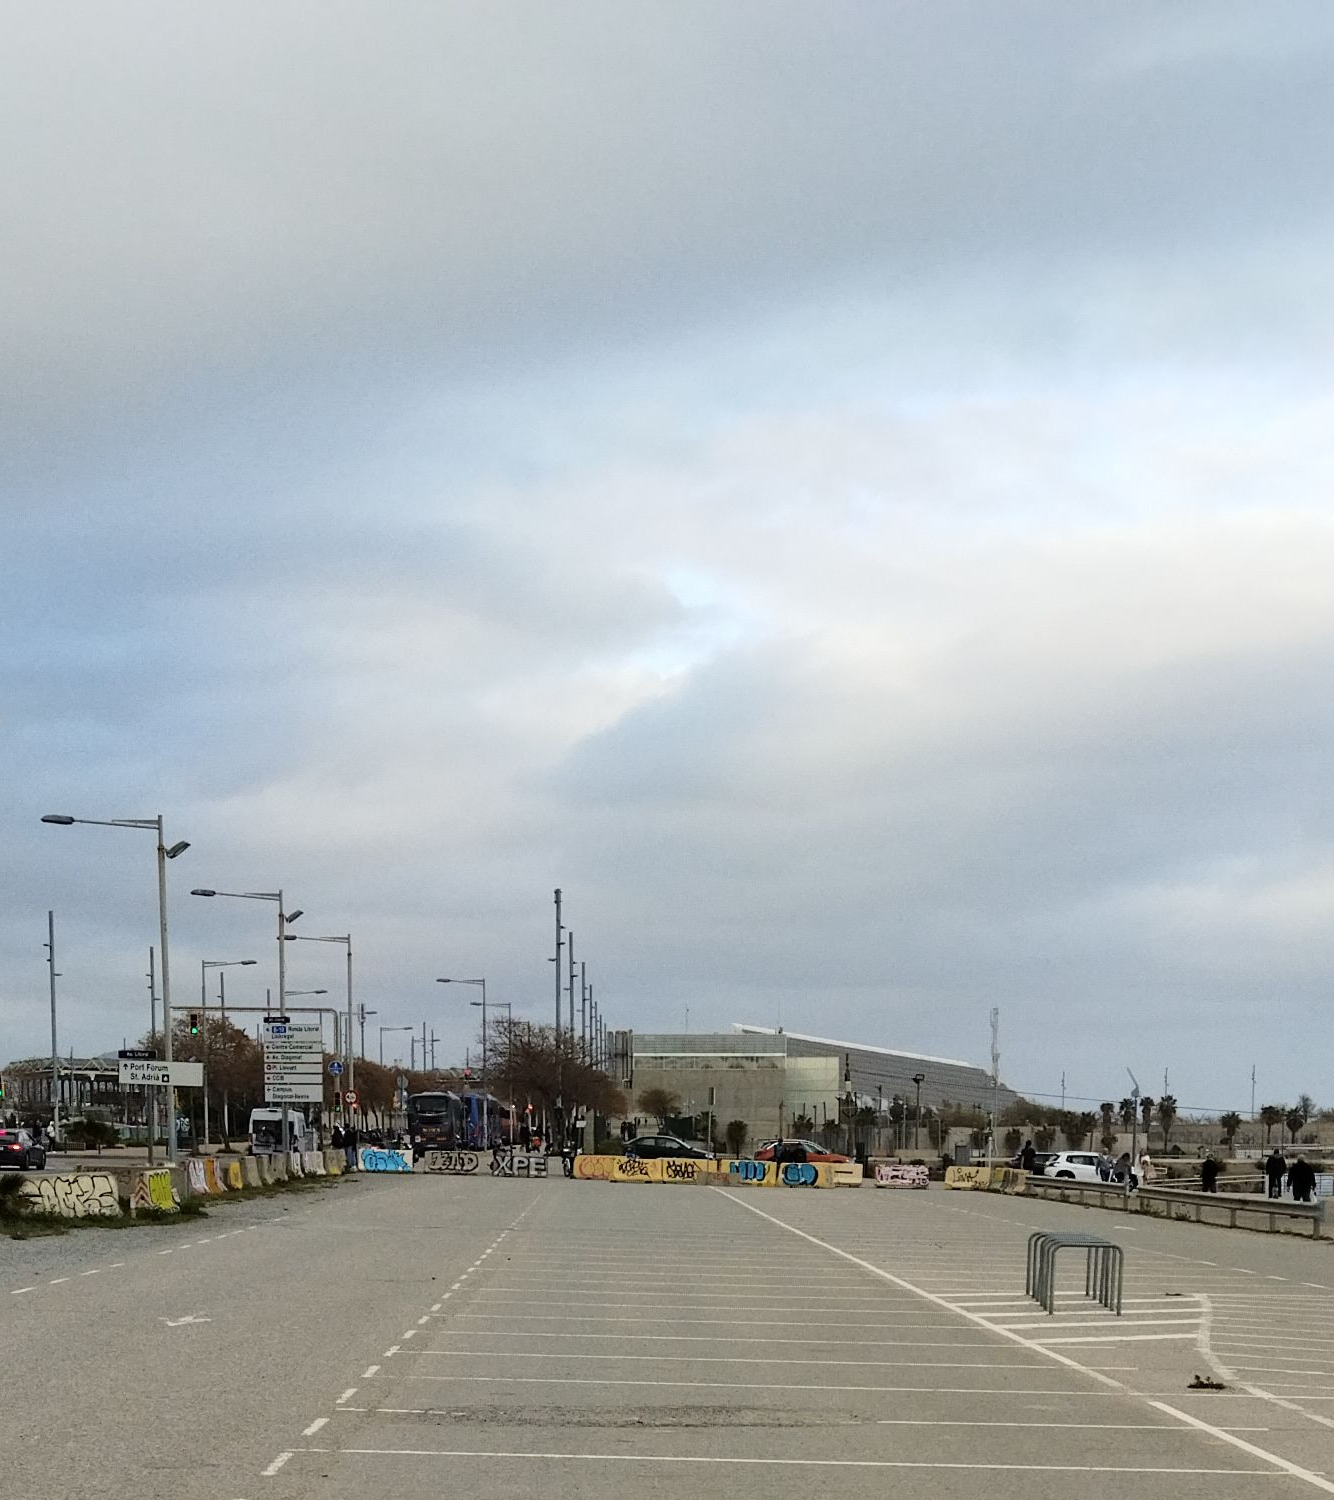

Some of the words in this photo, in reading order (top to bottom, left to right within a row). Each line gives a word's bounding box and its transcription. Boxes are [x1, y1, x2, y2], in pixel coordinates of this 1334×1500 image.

[130, 1063, 145, 1071] Port
[130, 1073, 140, 1081] St.
[492, 1156, 548, 1178] XPE
